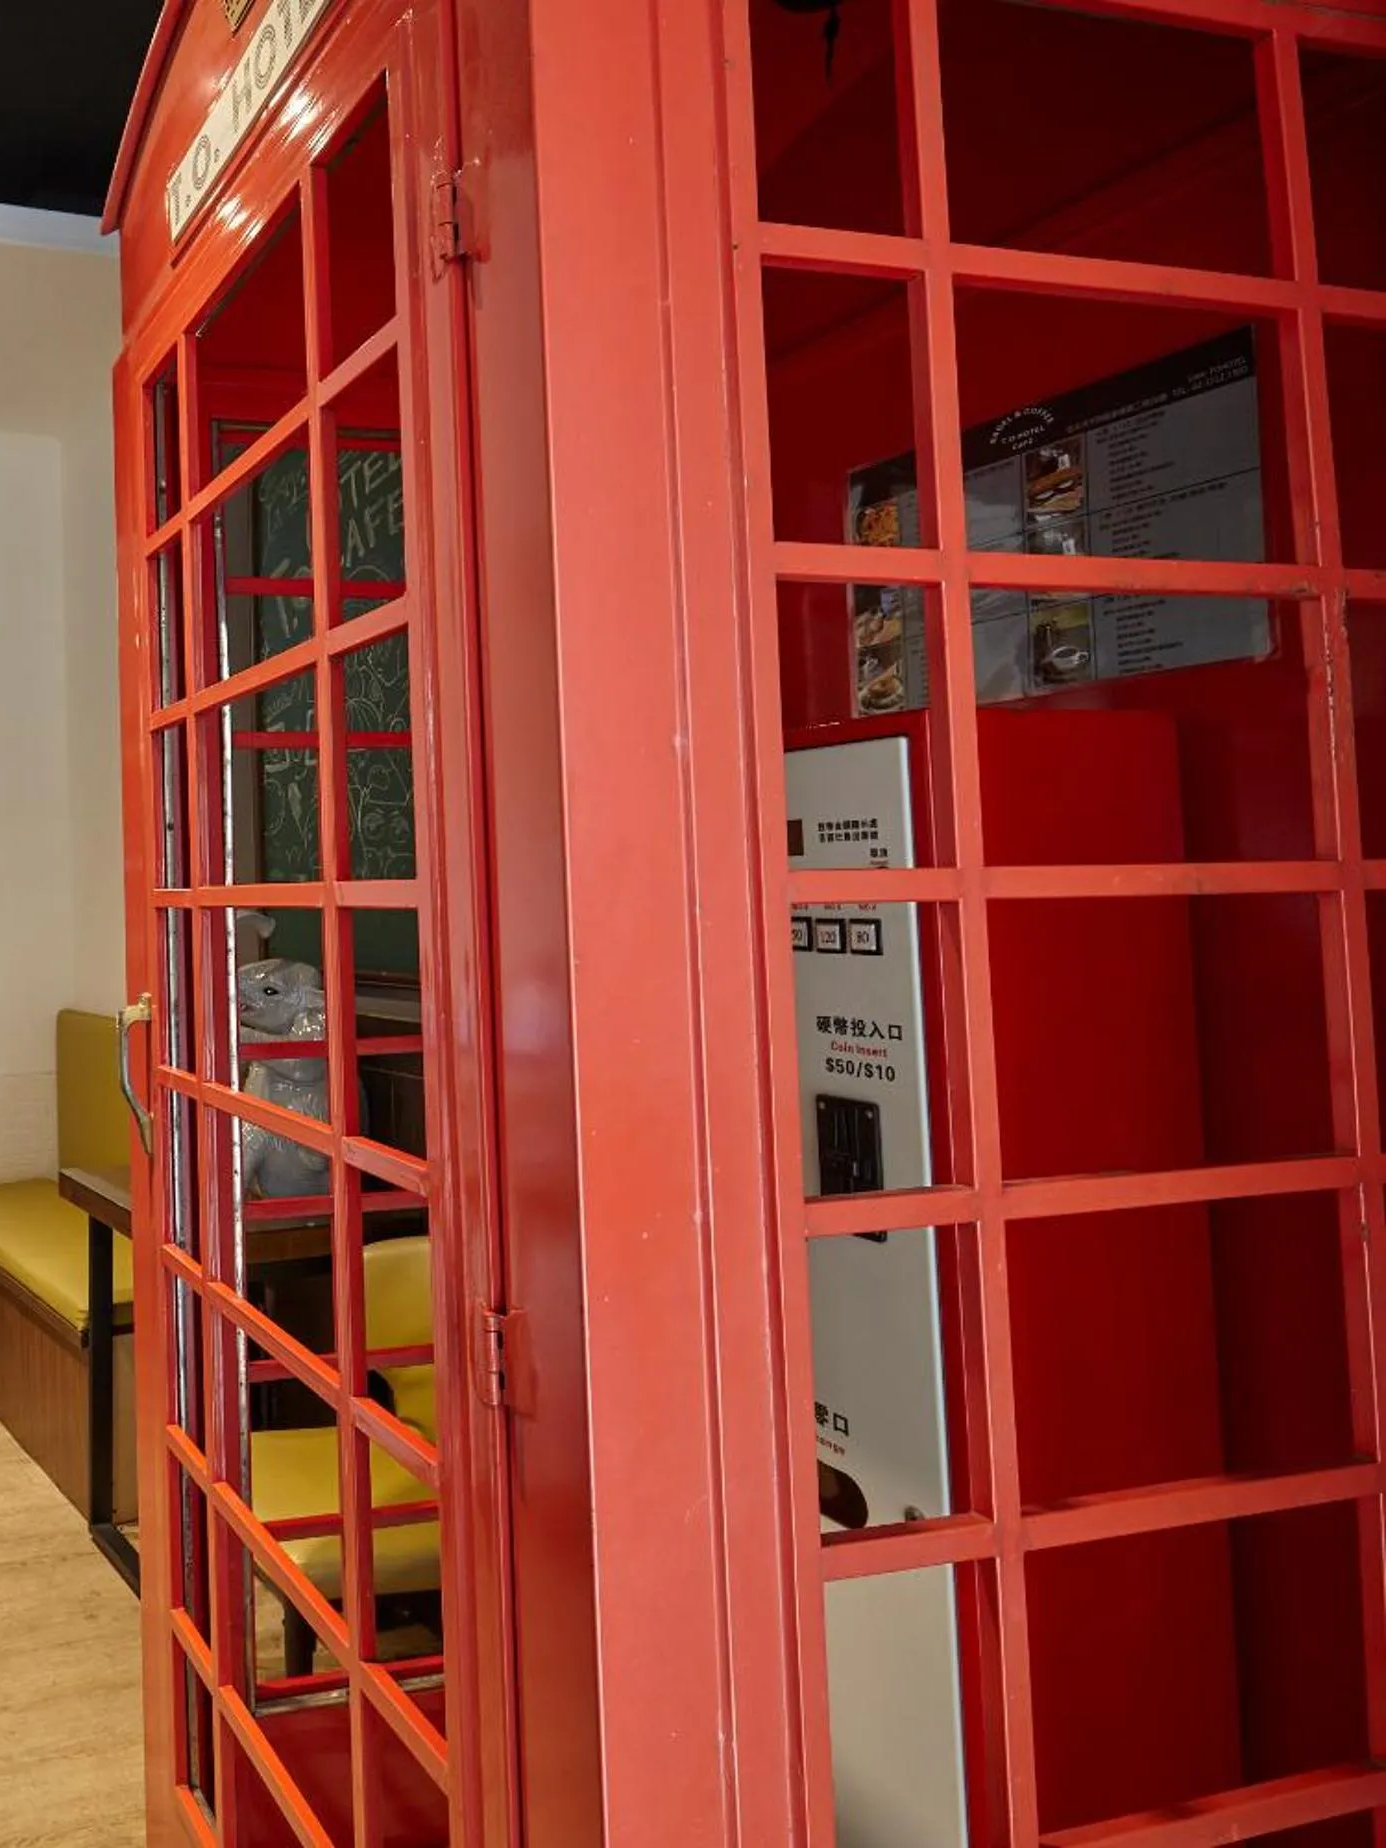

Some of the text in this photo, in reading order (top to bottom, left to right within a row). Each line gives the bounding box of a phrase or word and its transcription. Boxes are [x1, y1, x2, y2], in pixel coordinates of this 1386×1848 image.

[816, 1015, 903, 1041] 硬幣投入口
[825, 1056, 896, 1082] $50/$10
